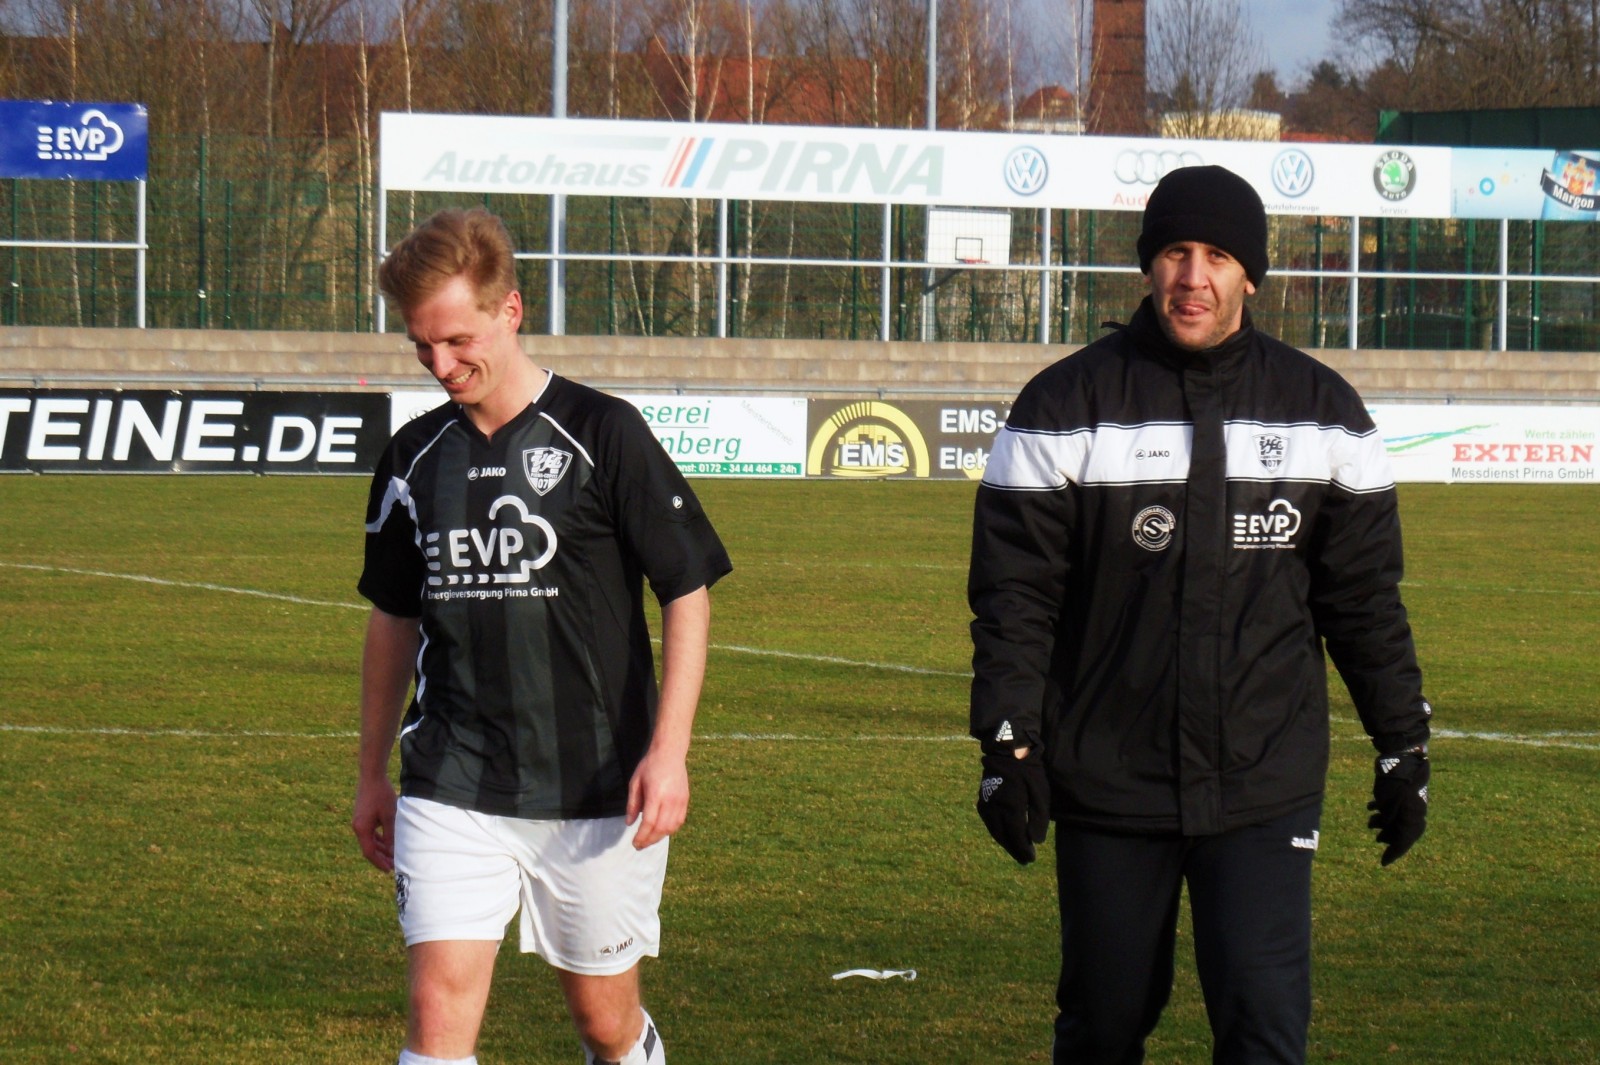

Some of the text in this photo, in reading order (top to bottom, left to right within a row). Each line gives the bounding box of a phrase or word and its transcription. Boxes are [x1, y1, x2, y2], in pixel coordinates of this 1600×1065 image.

[57, 127, 105, 151] EVP
[421, 138, 946, 197] Autohaus PIRNA
[1553, 184, 1595, 209] Margon
[940, 409, 1011, 434] EMS-
[1524, 428, 1595, 440] Werte zählen
[841, 443, 905, 467] EMS
[1147, 450, 1170, 458] JAKO
[1452, 443, 1594, 463] EXTERN
[480, 466, 507, 478] JAKO
[699, 463, 721, 473] 0172
[729, 464, 741, 473] 34
[742, 464, 754, 474] 44
[756, 464, 772, 474] 464
[780, 464, 797, 474] 24h
[1267, 459, 1277, 468] 07
[1451, 467, 1595, 479] Messdienst Pirna GmbH
[537, 478, 549, 489] 07
[1249, 514, 1290, 534] EVP
[448, 528, 524, 567] EVP
[427, 587, 559, 601] Energieversorgung Pirna GmbH
[615, 936, 634, 954] JAKO
